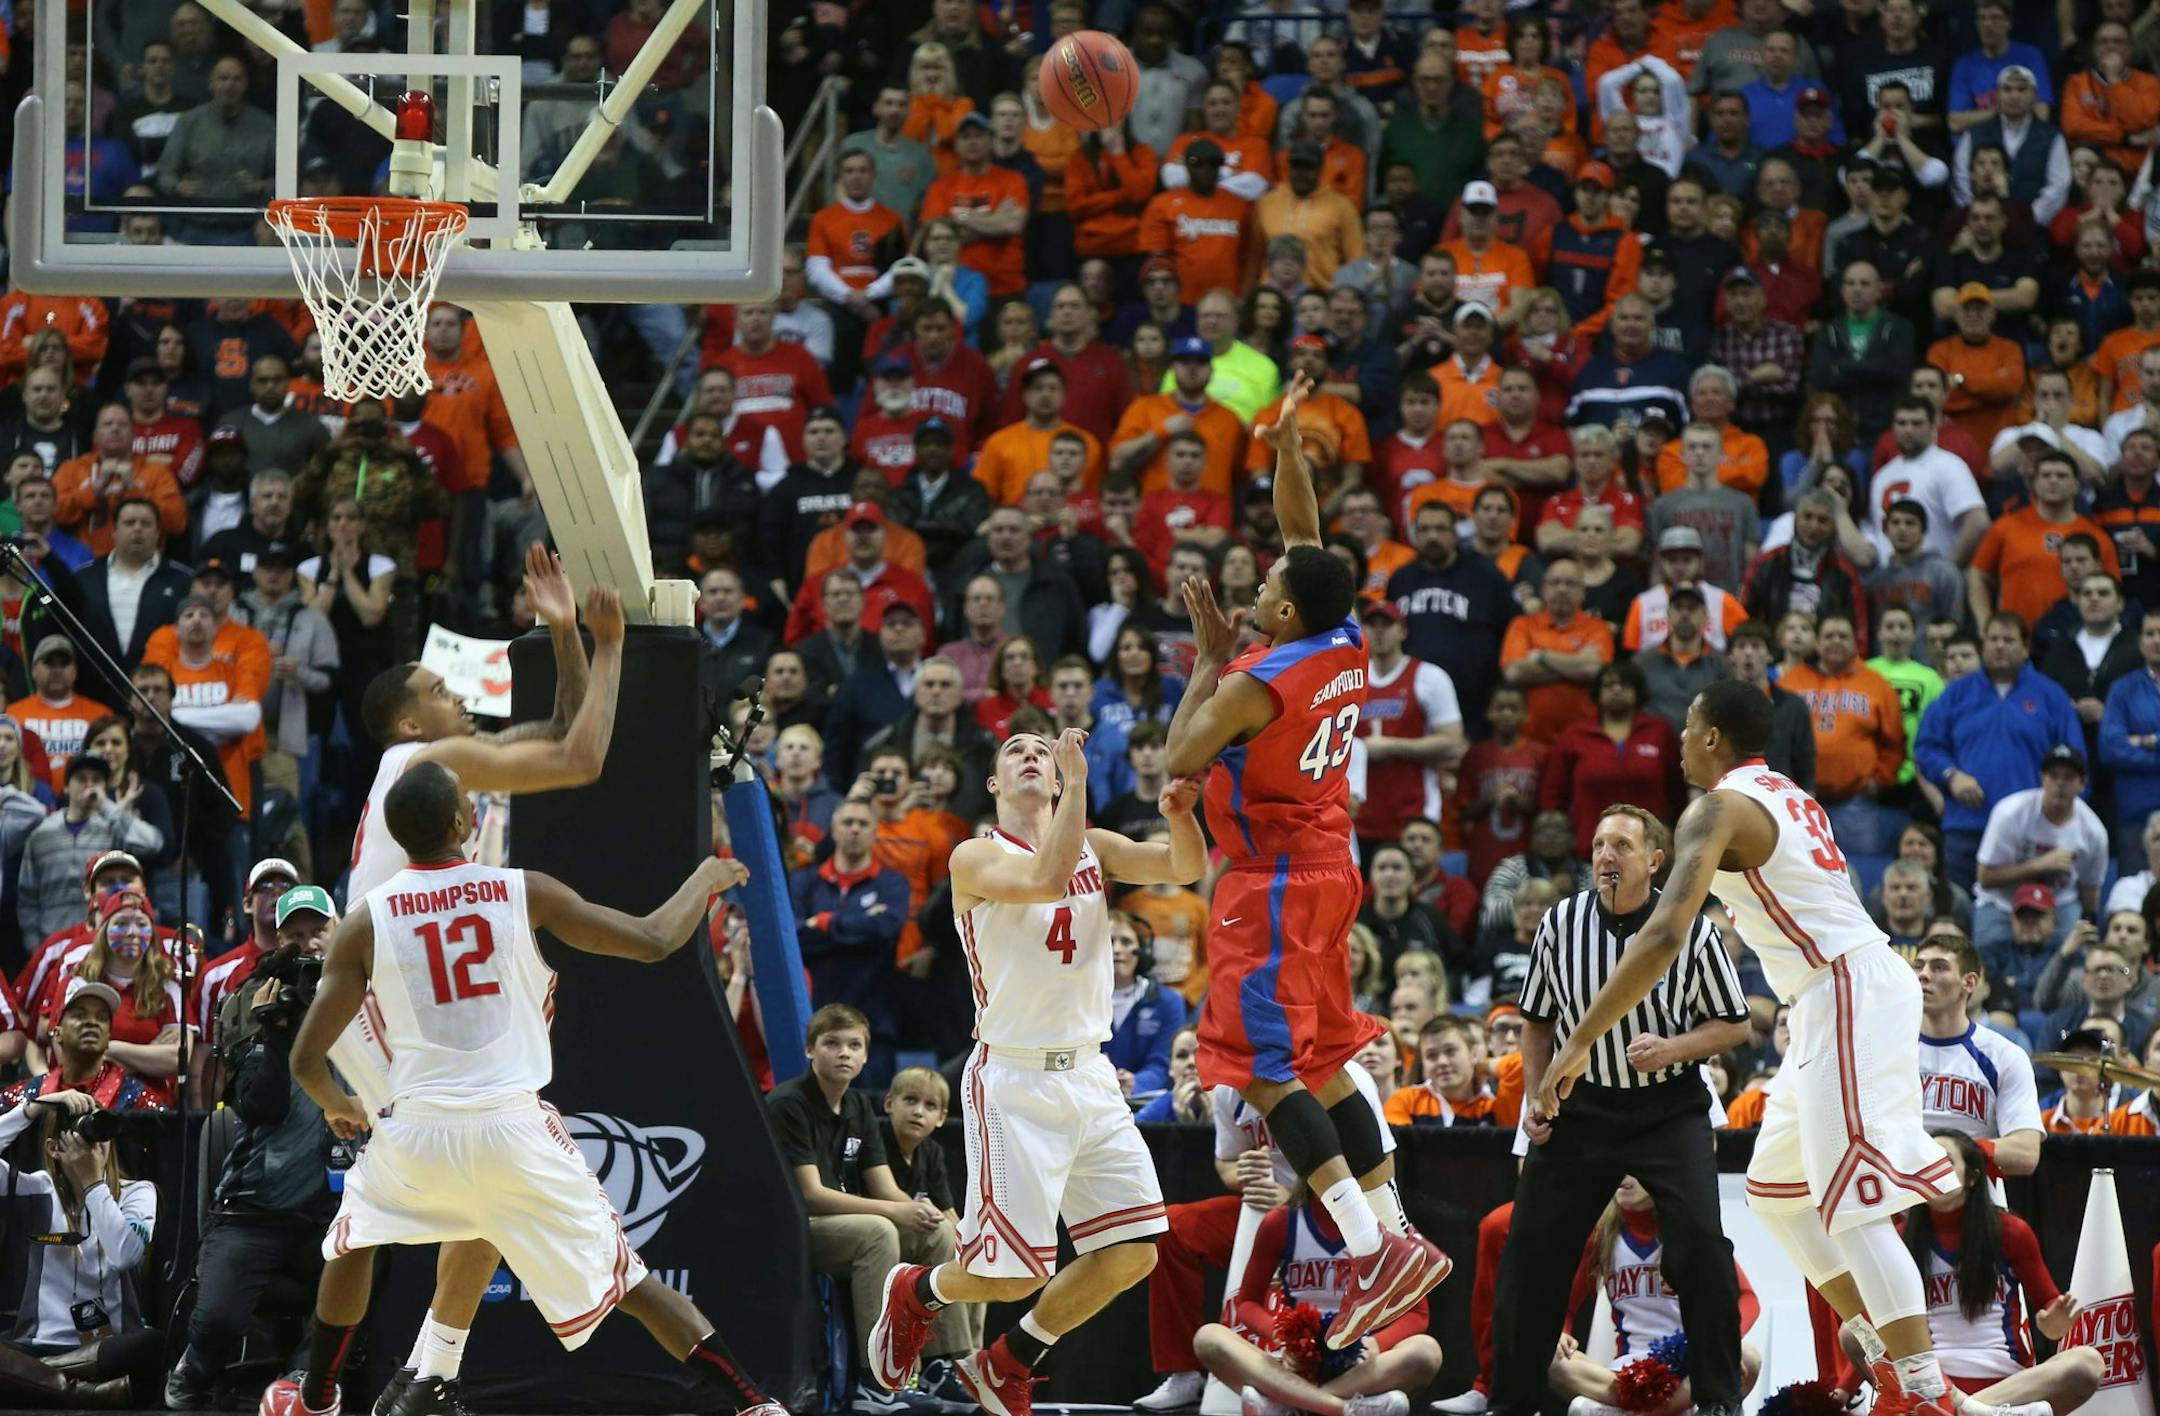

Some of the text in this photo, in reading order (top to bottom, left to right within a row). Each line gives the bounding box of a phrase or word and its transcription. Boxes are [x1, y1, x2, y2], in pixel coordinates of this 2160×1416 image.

[215, 337, 248, 379] S
[910, 387, 969, 418] AYTON
[1397, 587, 1470, 621] DAYTON
[1310, 668, 1365, 710] SANFORD
[1298, 702, 1361, 781] 43
[386, 880, 509, 919] THOMPSON
[1068, 865, 1102, 897] ATE
[1046, 905, 1078, 964] 4
[414, 914, 503, 1006] 12
[1918, 1073, 1988, 1123] YTON
[544, 1115, 576, 1156] BUCKEYES
[1288, 1258, 1346, 1293] DAYT
[1605, 1264, 1679, 1303] DAYT
[2061, 1300, 2134, 1350] AYTO
[2097, 1340, 2145, 1380] ERS
